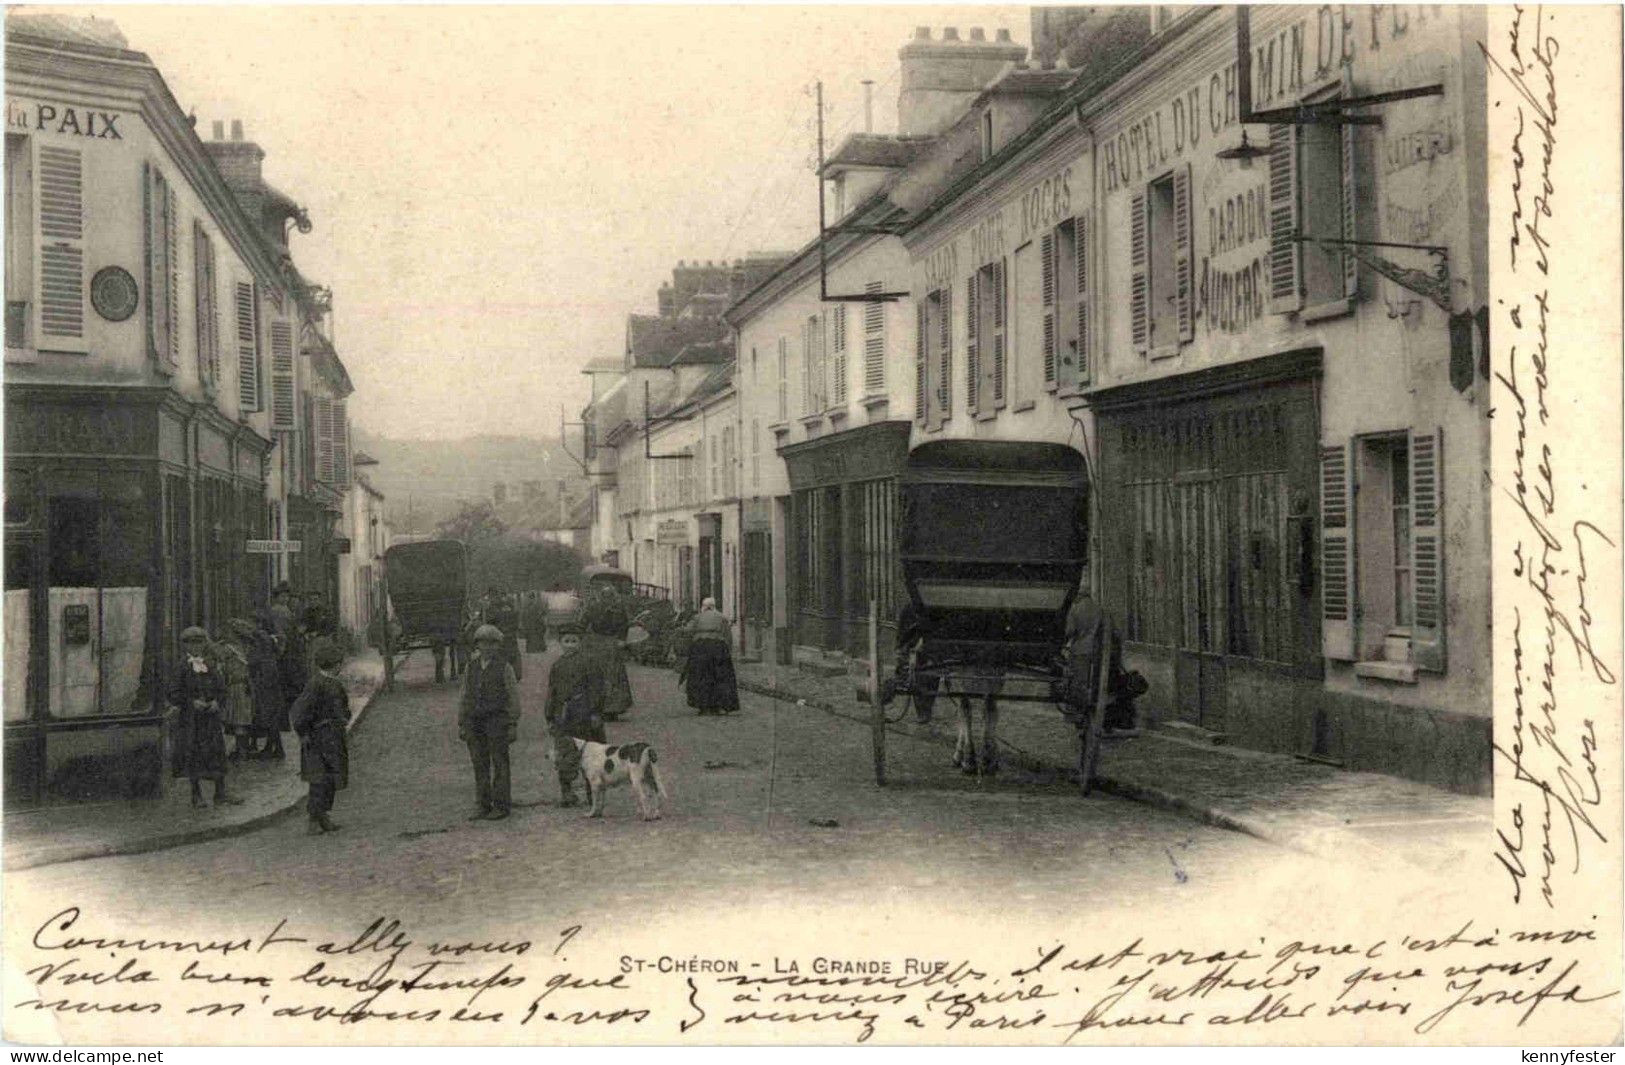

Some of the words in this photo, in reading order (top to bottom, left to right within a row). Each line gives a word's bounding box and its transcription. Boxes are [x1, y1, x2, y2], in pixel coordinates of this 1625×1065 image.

[1172, 86, 1200, 153] DU
[1209, 24, 1304, 138] CHMIN
[1316, 6, 1355, 79] DE
[36, 103, 123, 140] PAIX
[971, 211, 1004, 269] POUR
[1021, 167, 1072, 241] NOCES
[1509, 914, 1597, 944] moi
[1443, 957, 1553, 975] vous
[943, 1000, 1046, 1030] Paris
[1208, 994, 1316, 1024] aller
